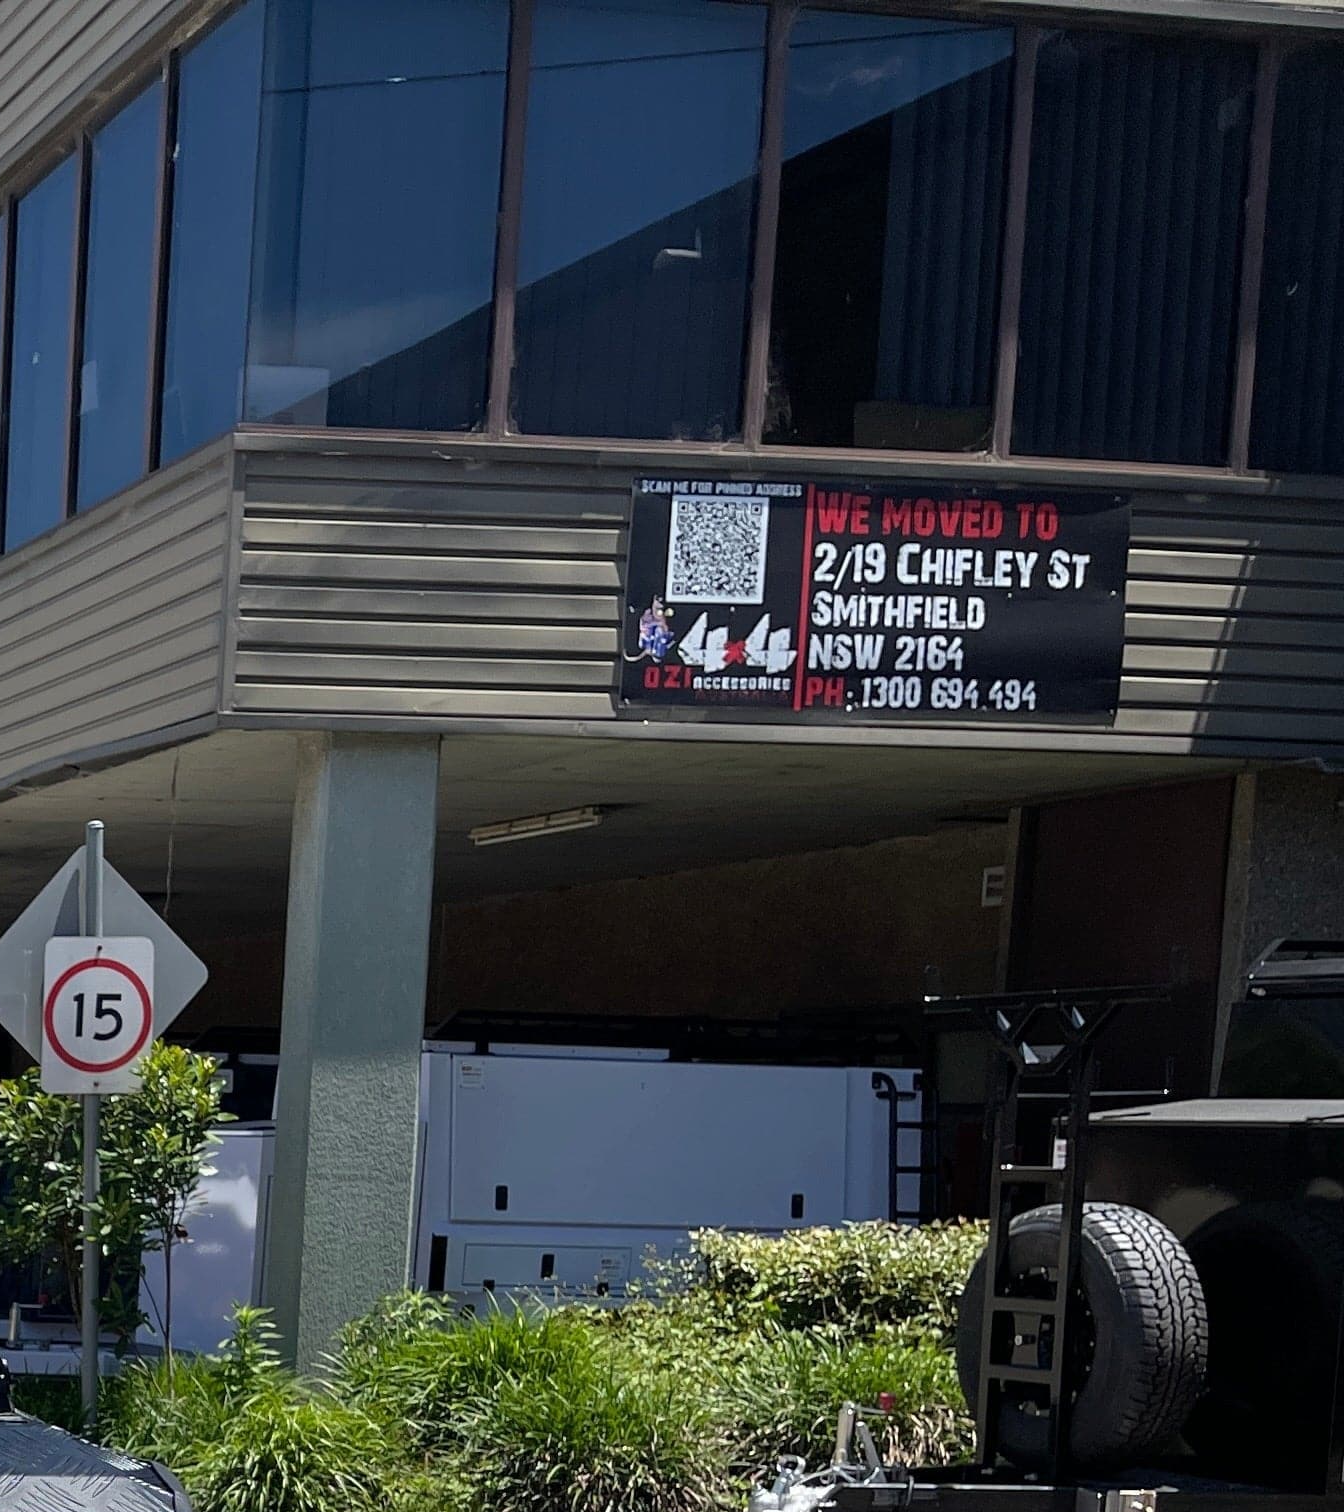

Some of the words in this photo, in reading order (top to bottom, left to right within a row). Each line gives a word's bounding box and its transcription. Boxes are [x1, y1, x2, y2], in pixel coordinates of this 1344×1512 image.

[642, 480, 671, 493] SCAN
[673, 481, 689, 493] ME
[691, 481, 712, 494] FOR
[755, 484, 802, 497] ADDRESS
[816, 491, 869, 534] WE
[882, 497, 1003, 538] MOVED
[1017, 502, 1058, 541] TO
[814, 542, 886, 590] 2/19
[897, 543, 1039, 588] CHIFLEY
[1047, 549, 1090, 589] ST
[811, 590, 985, 630] SMITHFIELD
[808, 633, 885, 670] NSW
[894, 635, 963, 671] 2164
[644, 665, 692, 688] OZI
[693, 676, 791, 690] ACCESSORIES
[862, 676, 921, 708] 1300
[931, 678, 979, 709] 694
[989, 679, 1035, 710] 494
[73, 993, 123, 1041] 15
